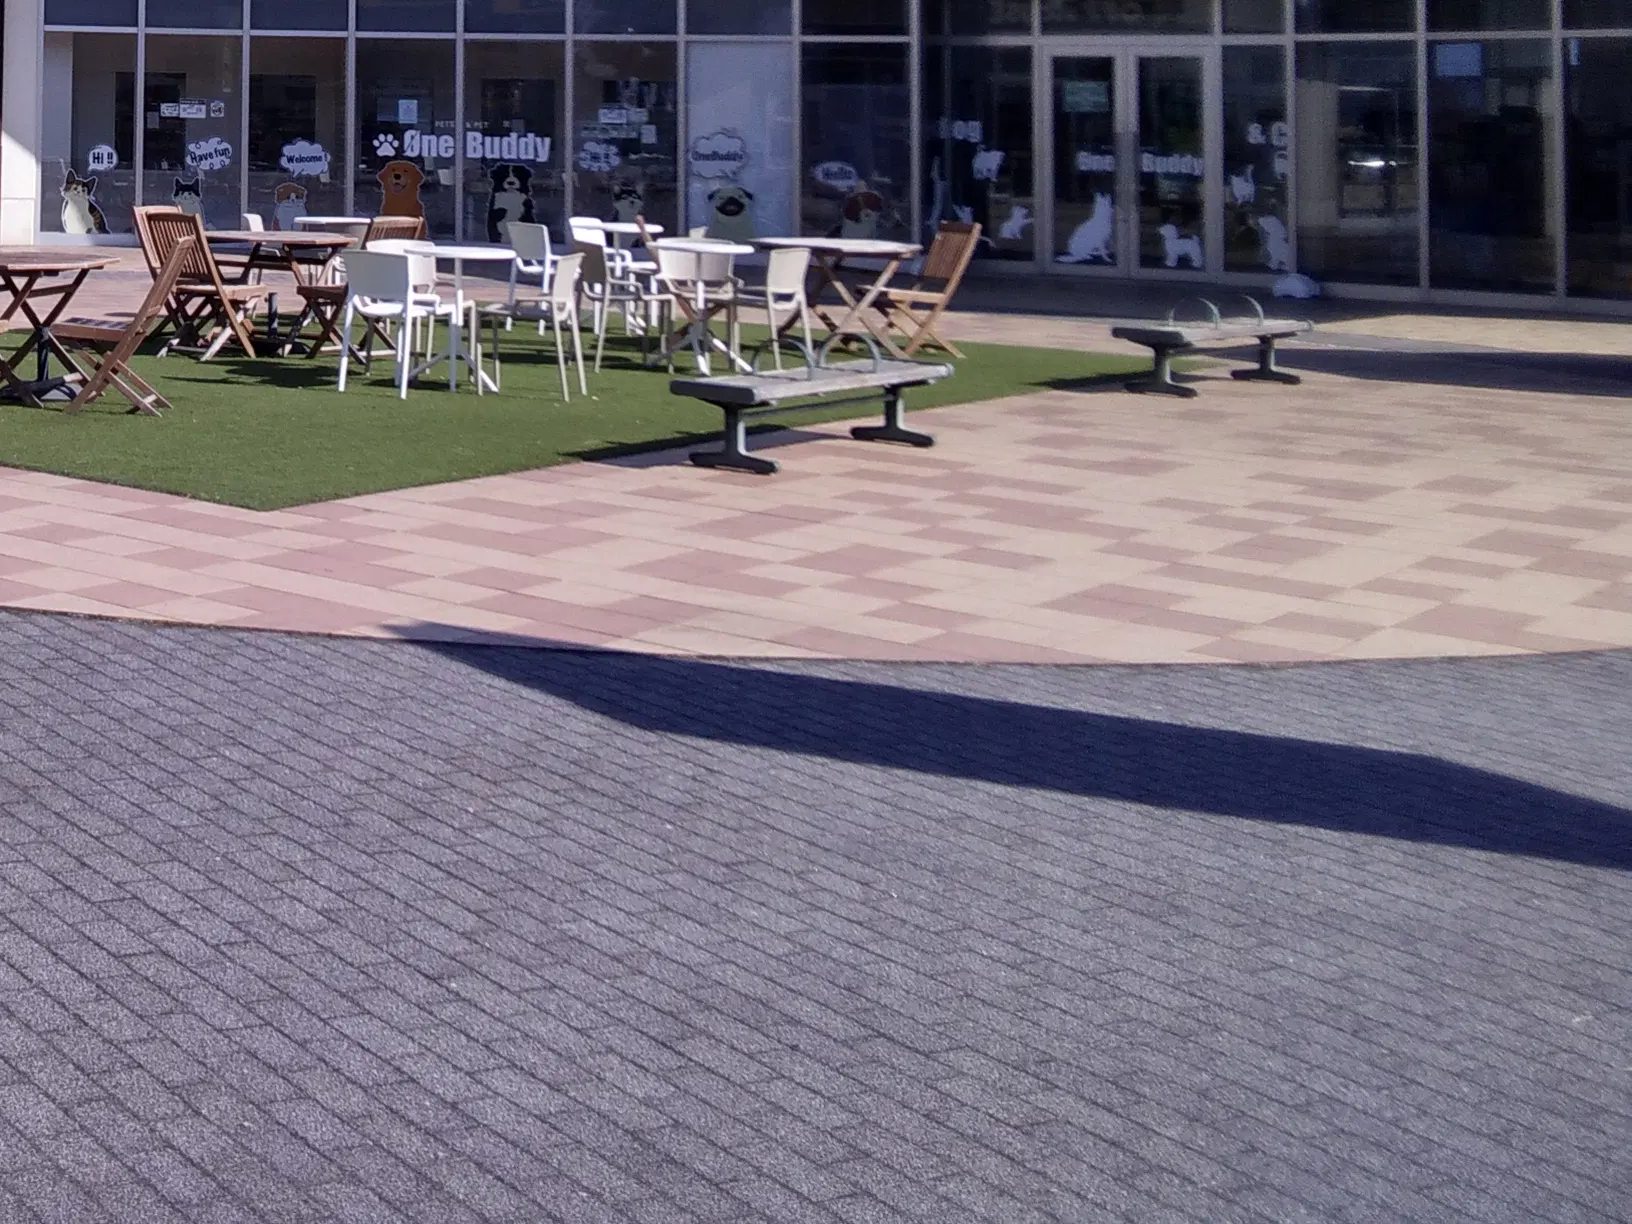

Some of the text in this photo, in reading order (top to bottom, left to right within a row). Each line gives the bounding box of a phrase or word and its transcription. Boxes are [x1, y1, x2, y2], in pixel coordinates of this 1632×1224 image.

[189, 146, 230, 164] Have fun
[466, 131, 551, 163] Buddy
[92, 152, 103, 164] Hi
[1141, 151, 1204, 176] Buddy
